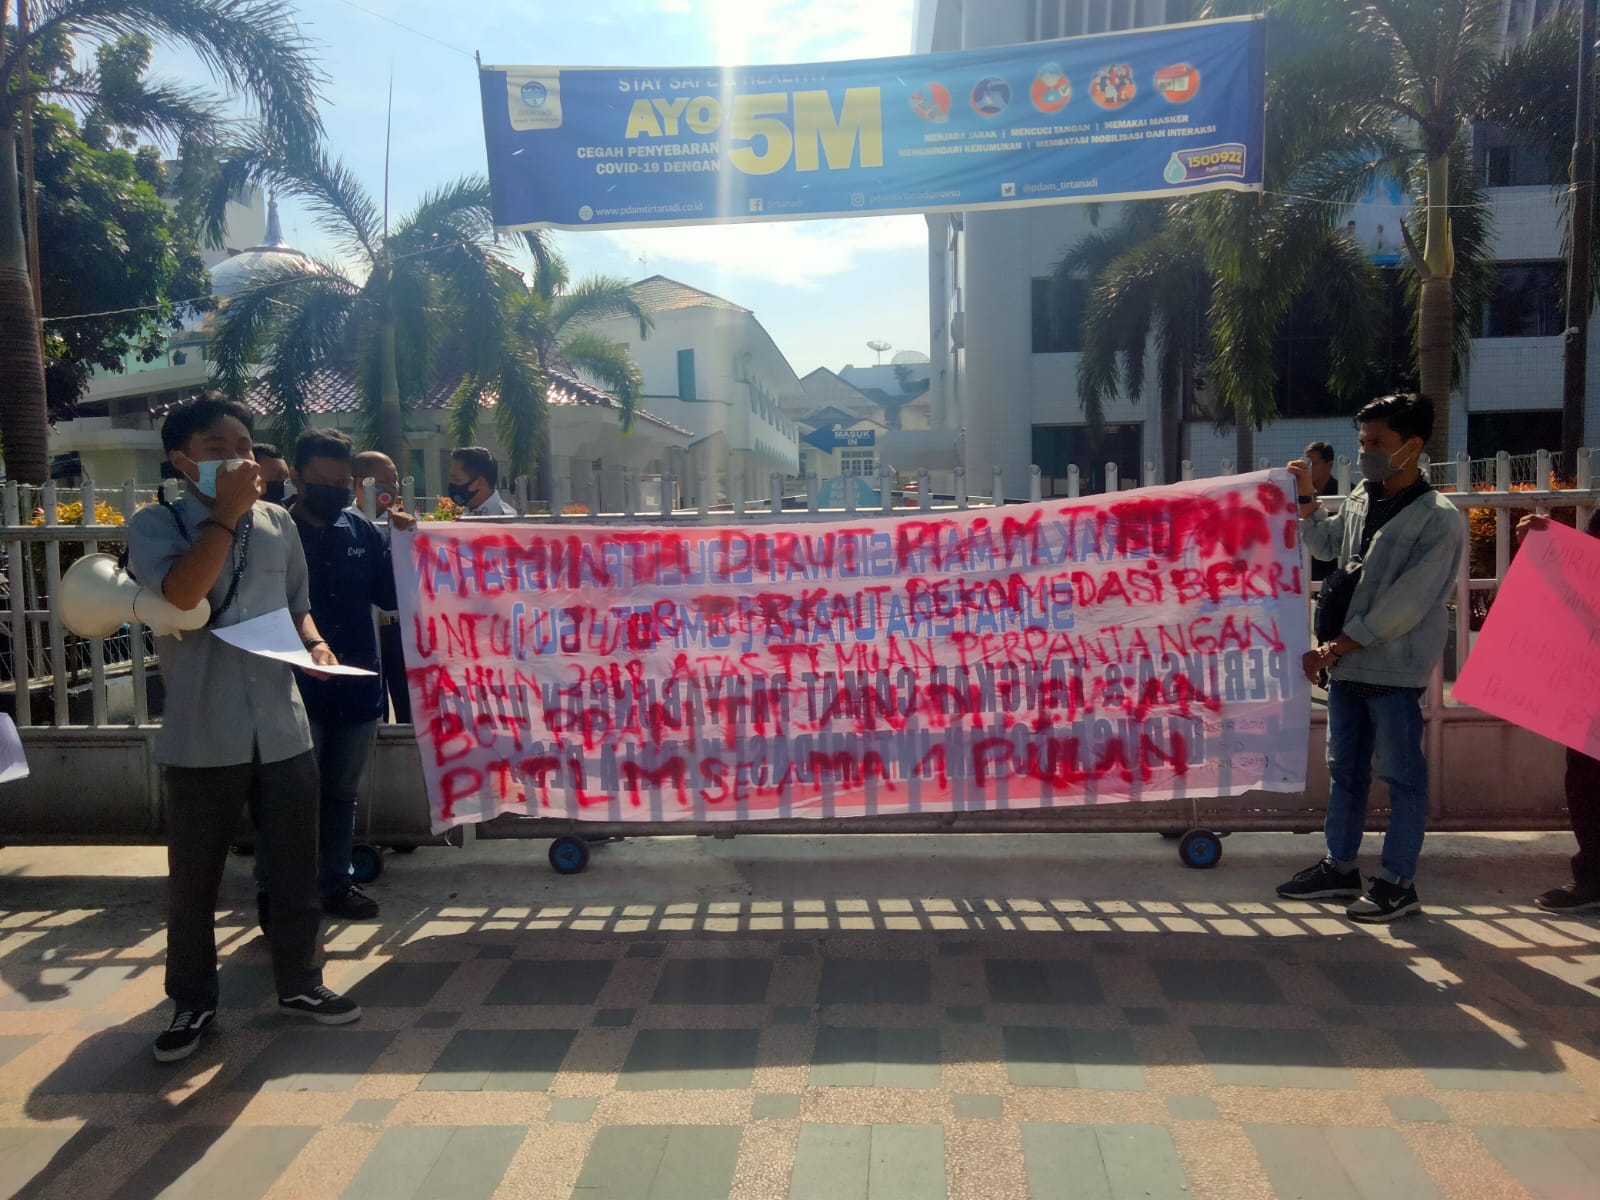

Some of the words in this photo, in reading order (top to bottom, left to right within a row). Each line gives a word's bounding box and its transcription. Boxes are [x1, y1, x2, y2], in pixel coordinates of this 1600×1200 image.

[624, 95, 723, 139] AYO
[728, 86, 883, 175] 5M
[1011, 127, 1051, 136] MENCUCI
[1054, 124, 1091, 134] TANGAN
[1104, 119, 1147, 129] MEMAKAI
[1150, 115, 1189, 125] MASKER
[964, 142, 1022, 153] KERUMUNAN
[1036, 135, 1089, 147] MEMBATASI
[1090, 131, 1144, 144] MOBILISASI
[1146, 128, 1166, 139] DAN
[1167, 125, 1216, 138] INTERAKSI
[577, 146, 624, 158] CEGAH
[627, 141, 721, 158] PENYEBARAN
[595, 162, 660, 175] COVID-19
[663, 159, 721, 173] DENGAN
[1187, 151, 1241, 168] 1500922
[1022, 177, 1098, 194] @pdam_tirtanadi
[595, 202, 703, 216] www.pdamtirtanadi.co.id
[834, 430, 870, 439] MASUK
[413, 608, 550, 659] UNTUK
[407, 662, 544, 709] TAHUN
[671, 652, 769, 698] ATAS
[768, 632, 937, 682] TEMUAN
